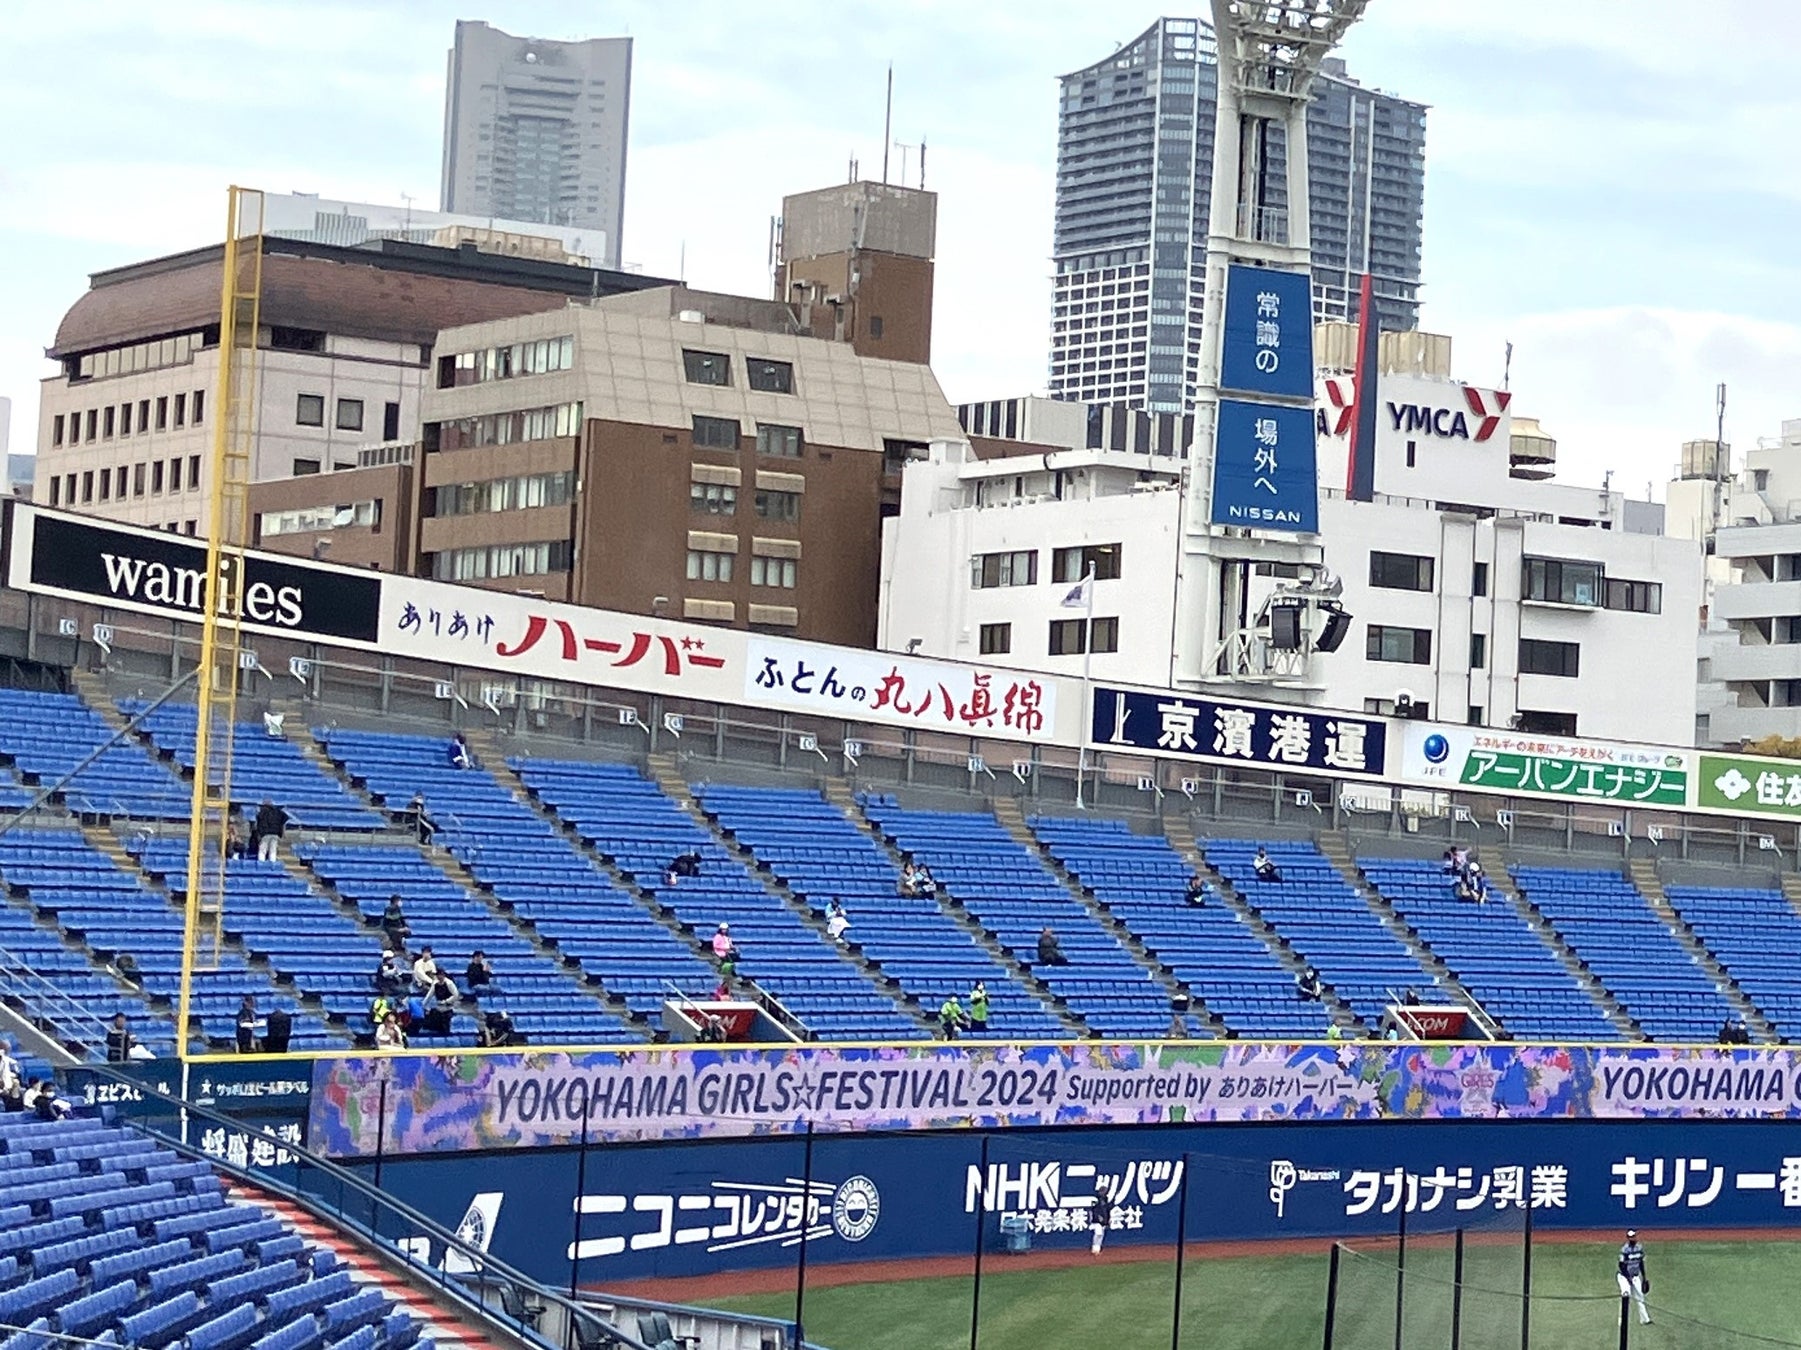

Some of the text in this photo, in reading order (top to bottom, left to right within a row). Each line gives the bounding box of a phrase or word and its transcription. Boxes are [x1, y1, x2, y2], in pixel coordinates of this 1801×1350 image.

[1255, 291, 1281, 373] 常識の
[1387, 402, 1469, 441] YMCA
[1254, 417, 1279, 495] 場外へ
[1229, 505, 1302, 523] NISSAN
[100, 553, 303, 626] wamiles
[1157, 700, 1367, 770] 京濱港運
[1469, 751, 1685, 799] アーバンエナジー
[498, 1075, 688, 1123] YOKOHAMA
[976, 1069, 1058, 1106] 2024
[1066, 1072, 1180, 1105] Supported
[1184, 1072, 1211, 1105] by
[1603, 1066, 1785, 1102] YOKOHAMA
[1343, 1163, 1569, 1216] タカナシ乳業
[567, 1194, 832, 1261] ニコニコレンタカー
